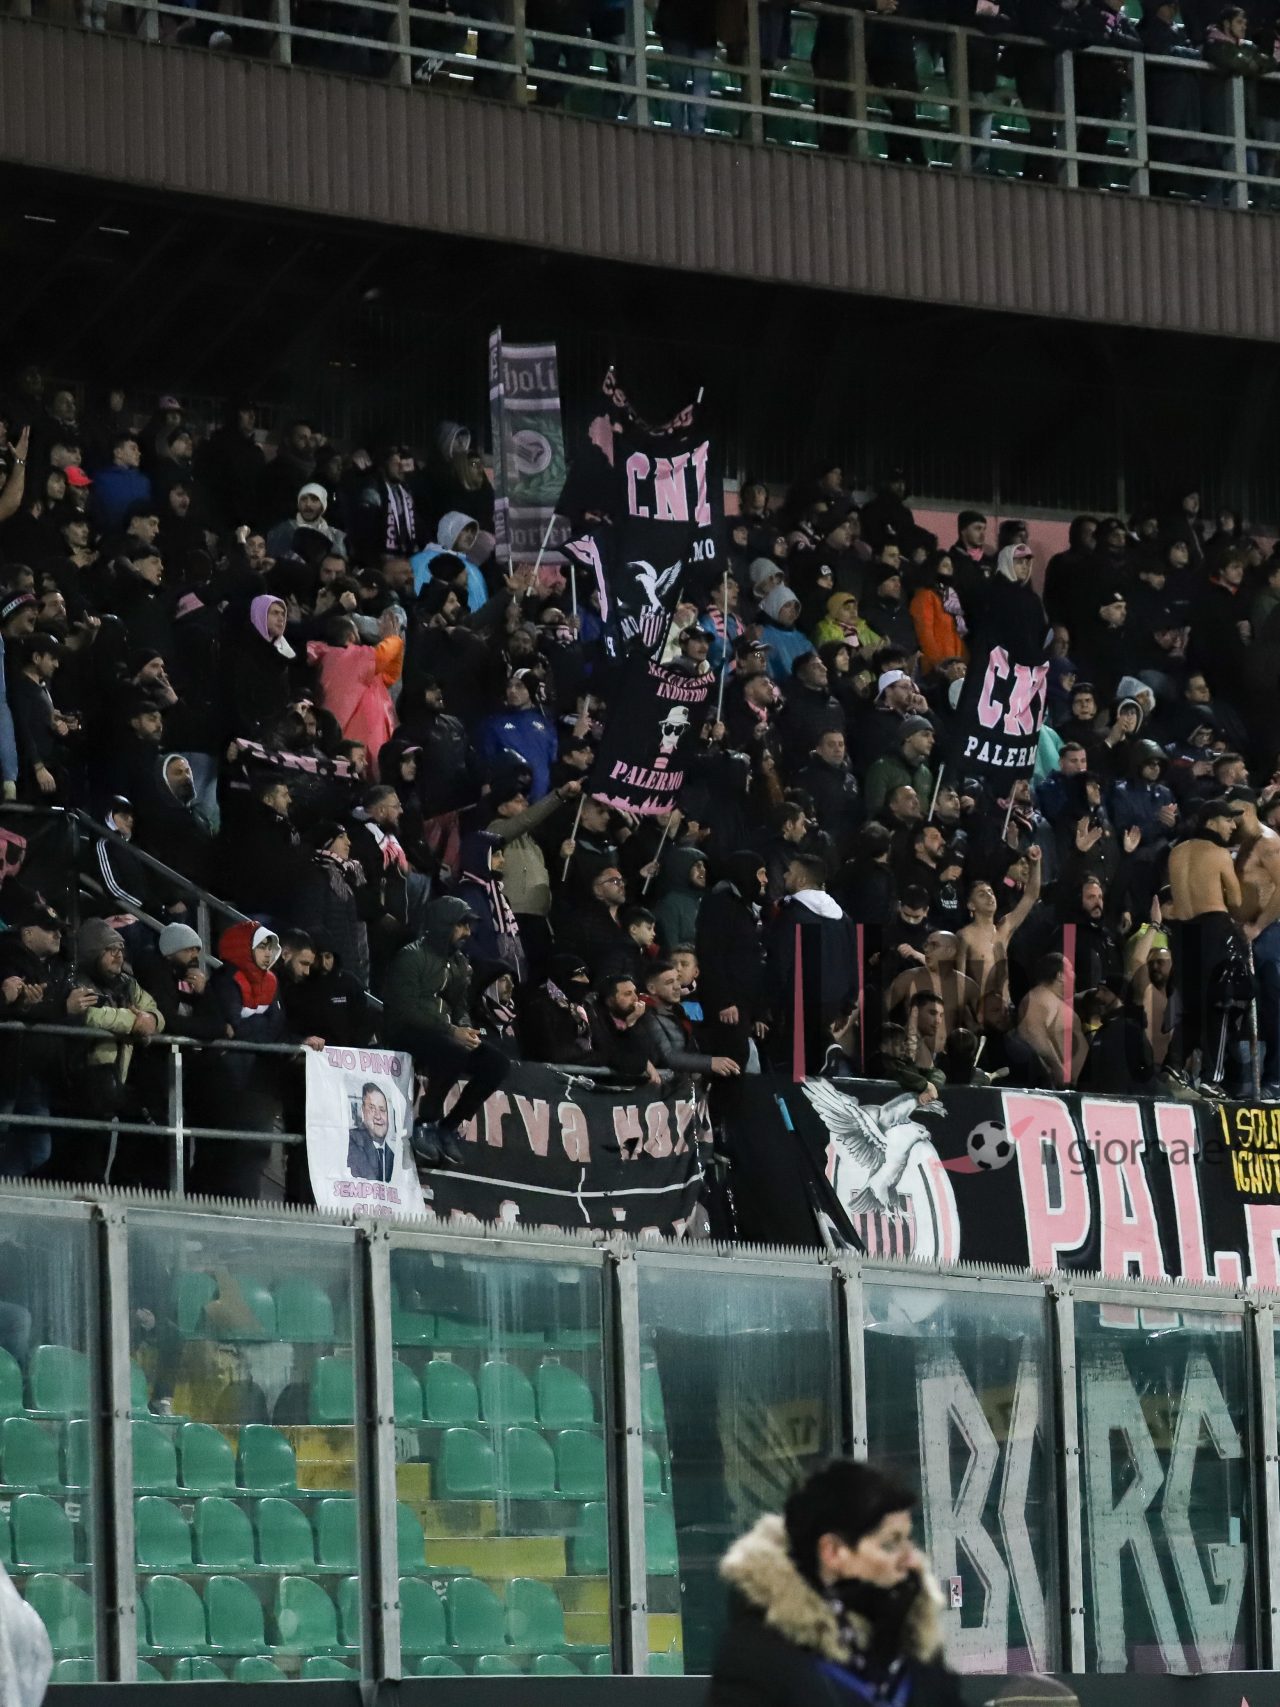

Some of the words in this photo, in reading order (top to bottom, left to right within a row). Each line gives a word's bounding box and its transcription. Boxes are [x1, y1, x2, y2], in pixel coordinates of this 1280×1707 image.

[626, 440, 711, 527] CNI
[609, 760, 684, 791] PALERMO
[326, 1048, 356, 1070] ZIO
[360, 1051, 402, 1077] PINO
